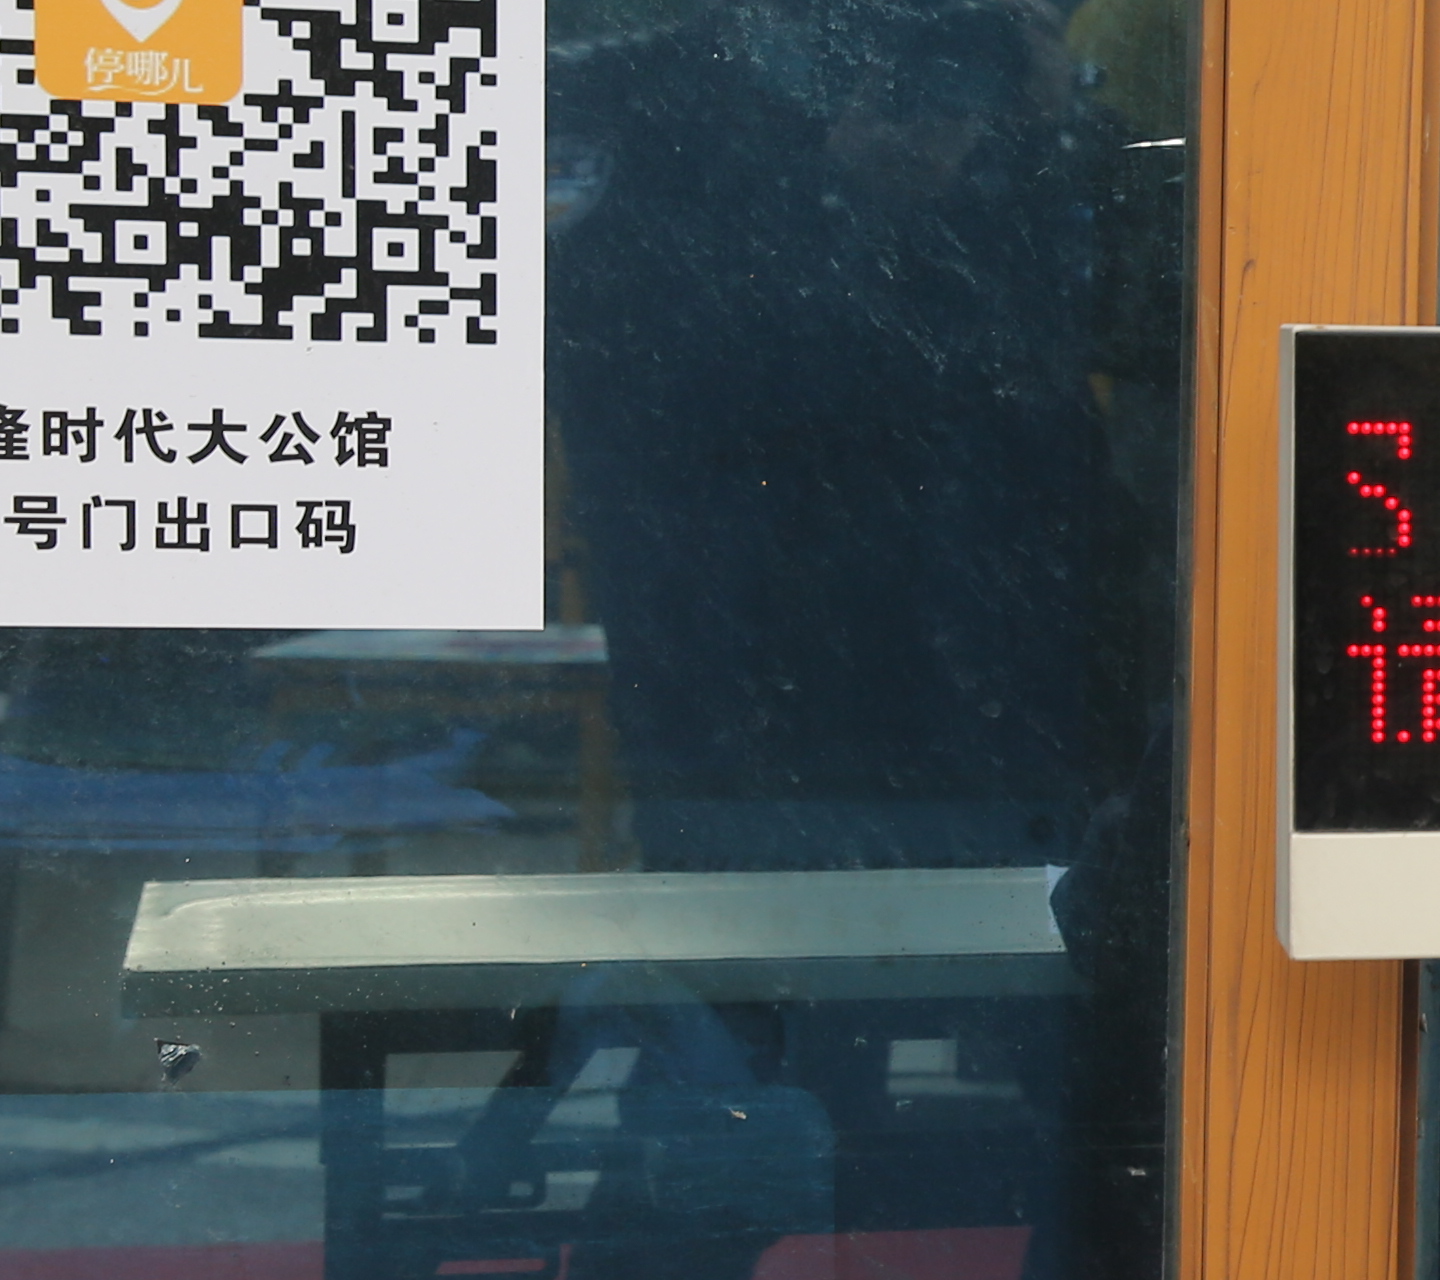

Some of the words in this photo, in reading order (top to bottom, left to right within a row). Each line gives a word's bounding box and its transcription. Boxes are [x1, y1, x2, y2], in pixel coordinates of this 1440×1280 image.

[84, 46, 204, 96] 停哪儿
[4, 495, 358, 554] 号门出口码
